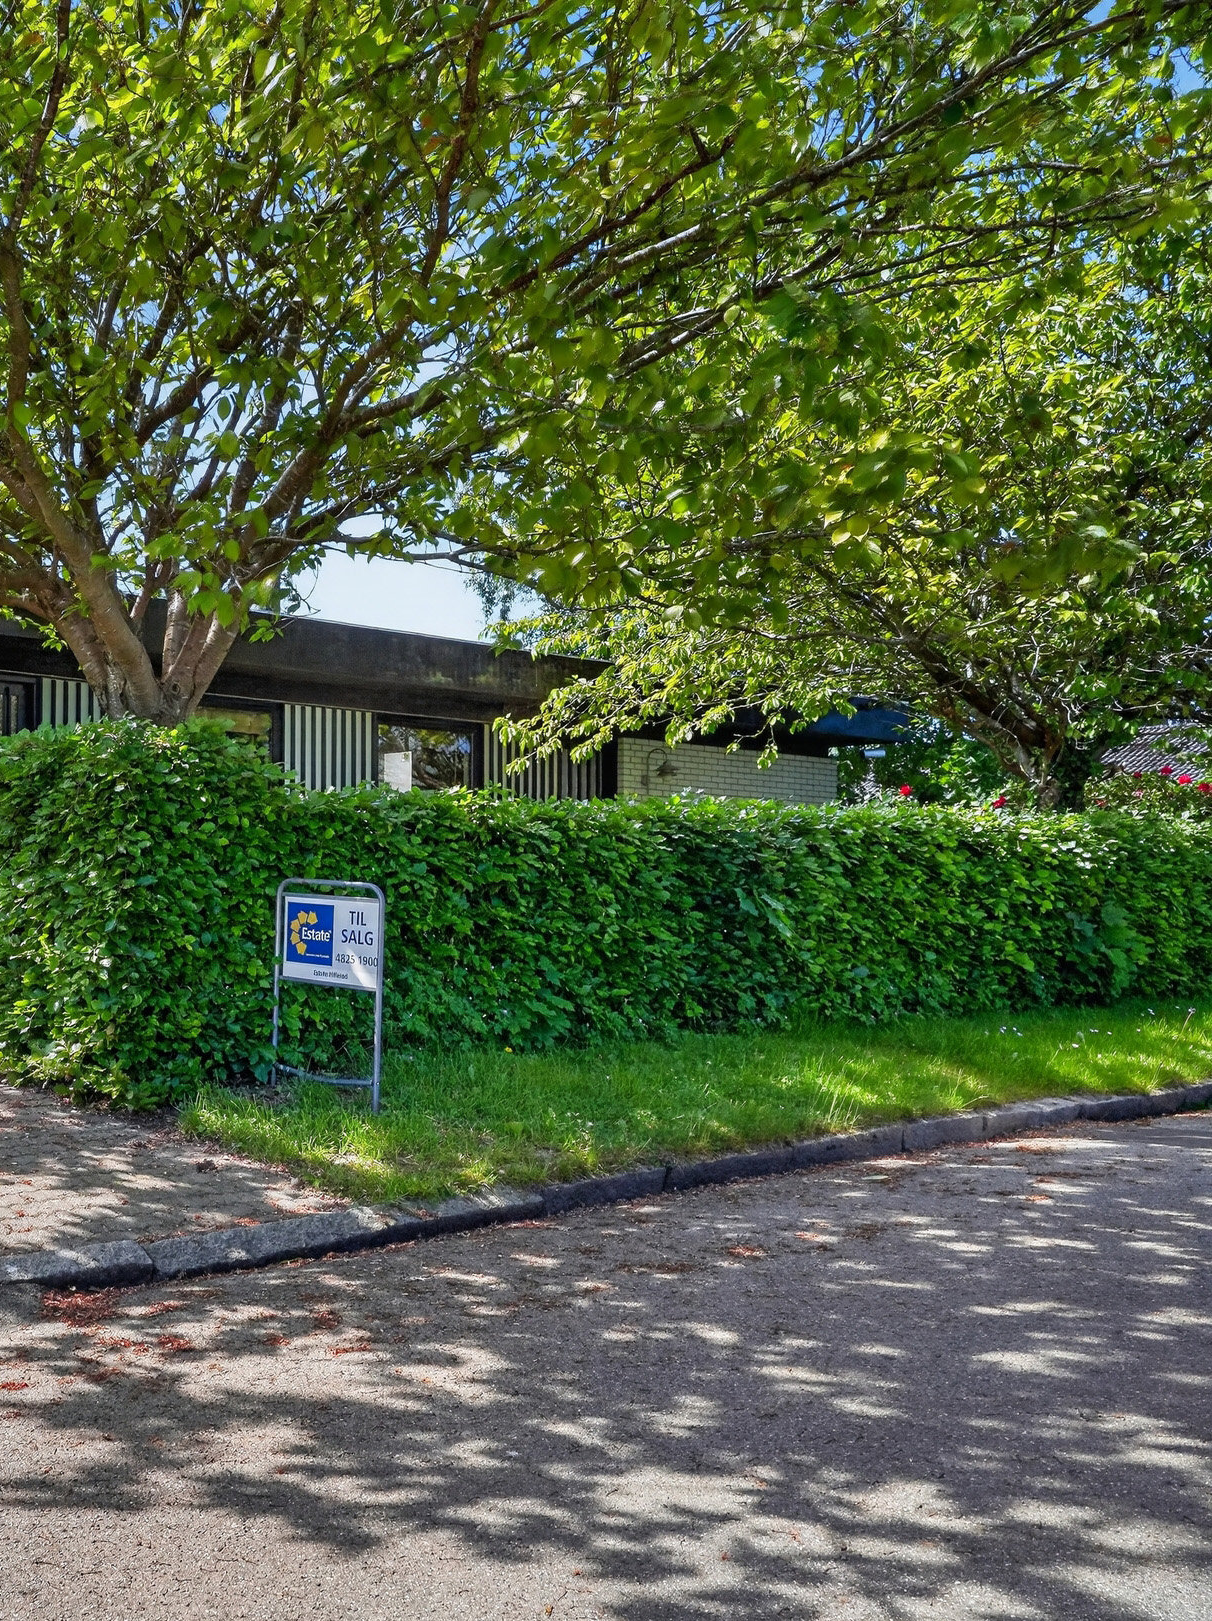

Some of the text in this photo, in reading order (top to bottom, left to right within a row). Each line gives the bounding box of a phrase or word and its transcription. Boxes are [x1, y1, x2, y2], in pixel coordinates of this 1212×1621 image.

[349, 911, 367, 926] TIL
[302, 927, 331, 942] Estate
[341, 929, 374, 946] SALG
[335, 953, 356, 965] 4825
[358, 955, 378, 968] 1900
